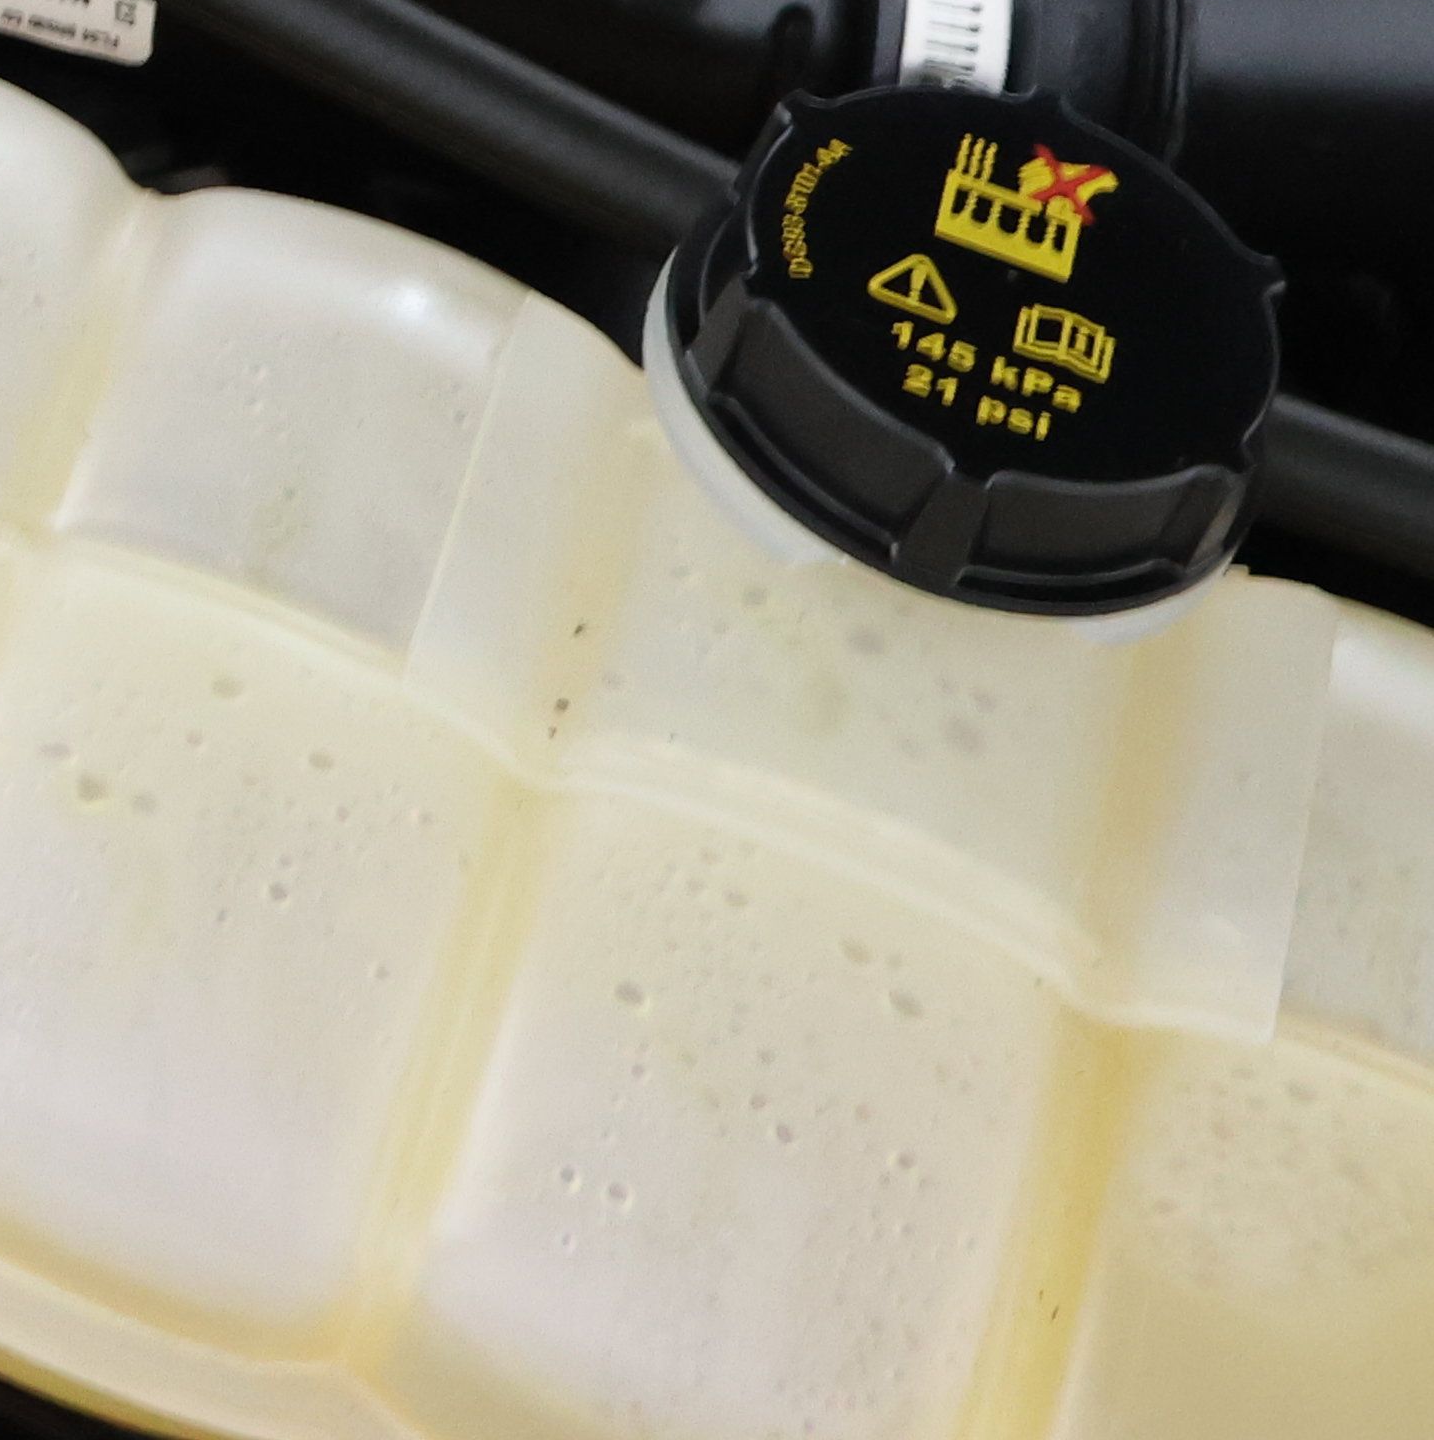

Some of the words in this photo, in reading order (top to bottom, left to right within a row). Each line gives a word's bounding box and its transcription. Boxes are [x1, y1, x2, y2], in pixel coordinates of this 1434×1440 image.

[891, 321, 978, 373] 145
[990, 356, 1082, 414] kPa
[902, 364, 959, 407] 21
[975, 395, 1051, 442] psi
